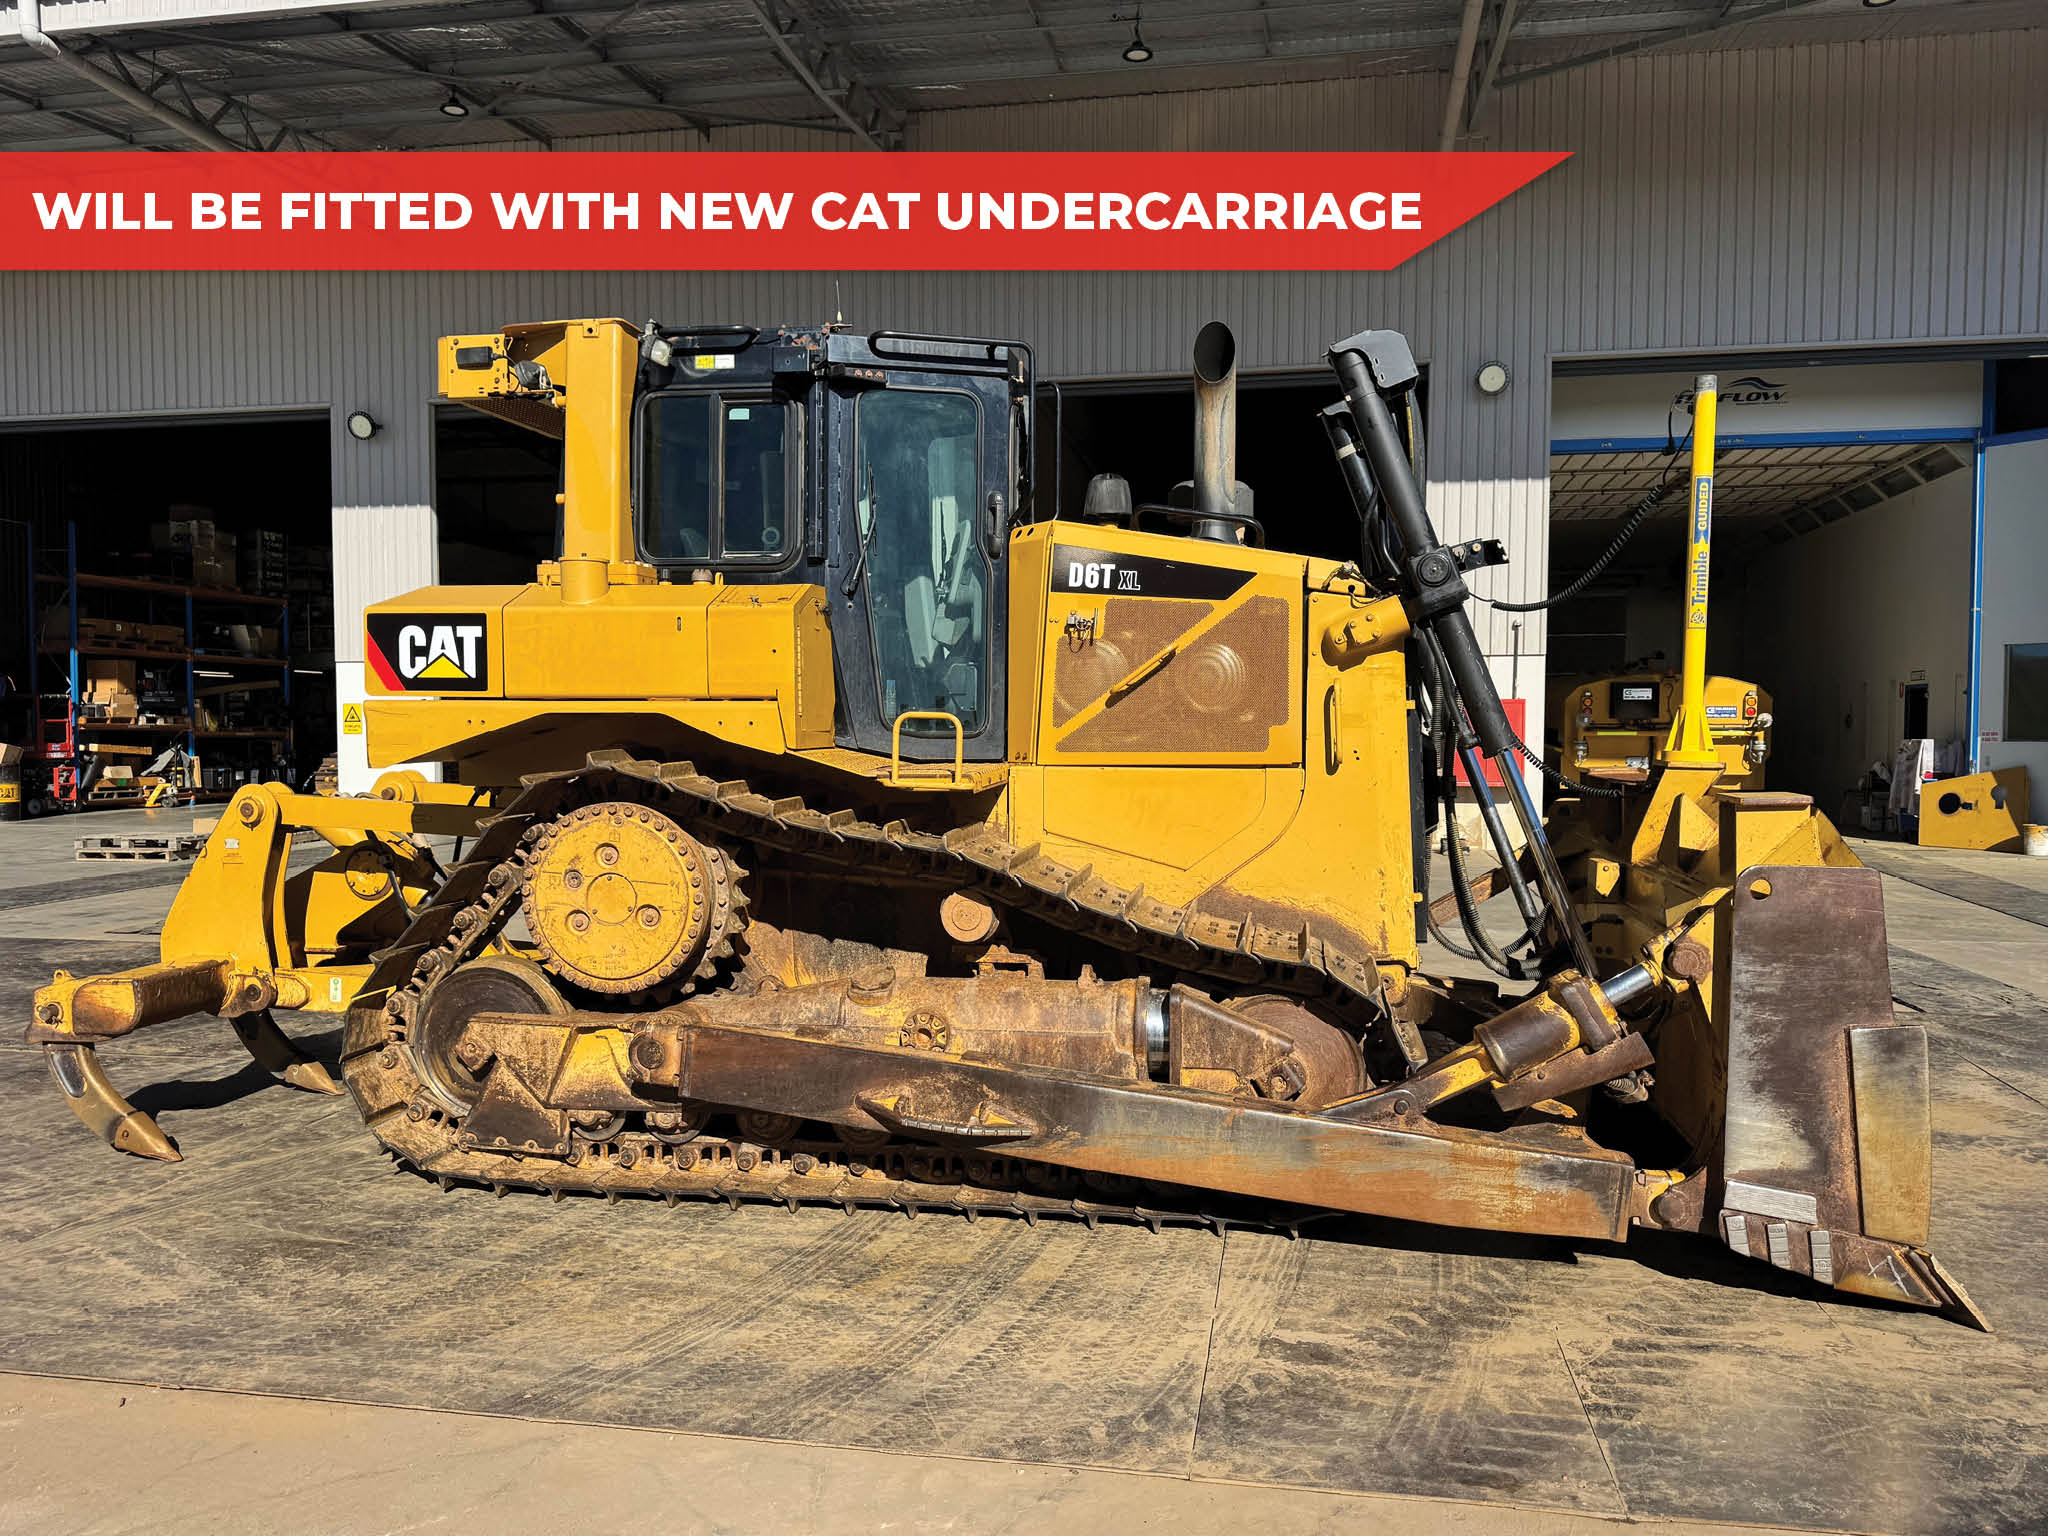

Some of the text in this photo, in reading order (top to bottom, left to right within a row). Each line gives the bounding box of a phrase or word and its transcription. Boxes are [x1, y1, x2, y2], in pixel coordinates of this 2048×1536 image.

[1692, 482, 1709, 605] Trimble GUIDED
[1068, 562, 1141, 590] D6T XL
[398, 624, 483, 679] CAT
